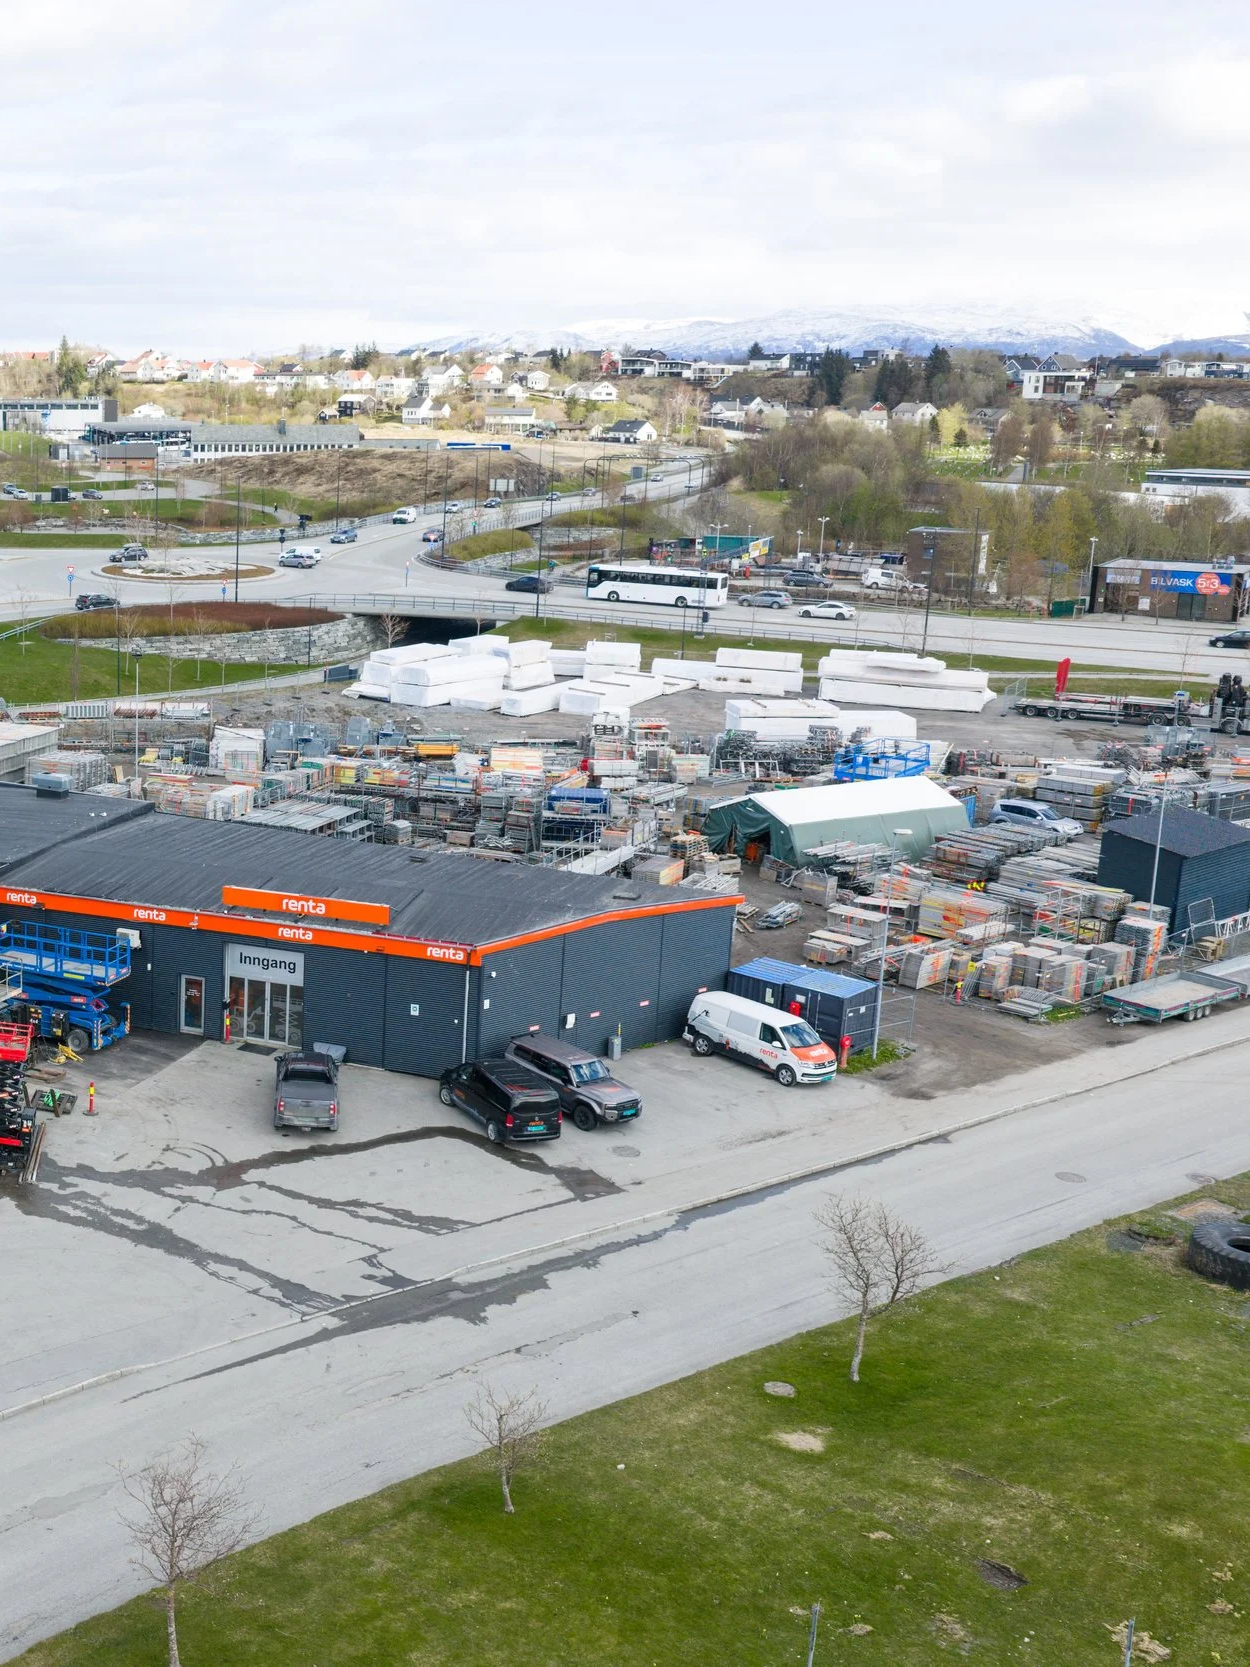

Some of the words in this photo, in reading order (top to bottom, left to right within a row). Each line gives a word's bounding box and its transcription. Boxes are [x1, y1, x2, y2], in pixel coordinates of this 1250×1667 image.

[6, 892, 37, 905] renta
[282, 898, 326, 914] renta
[133, 907, 166, 921] renta
[278, 926, 313, 941] renta
[426, 946, 464, 961] renta
[239, 952, 297, 974] Inngang
[760, 1047, 778, 1060] renta
